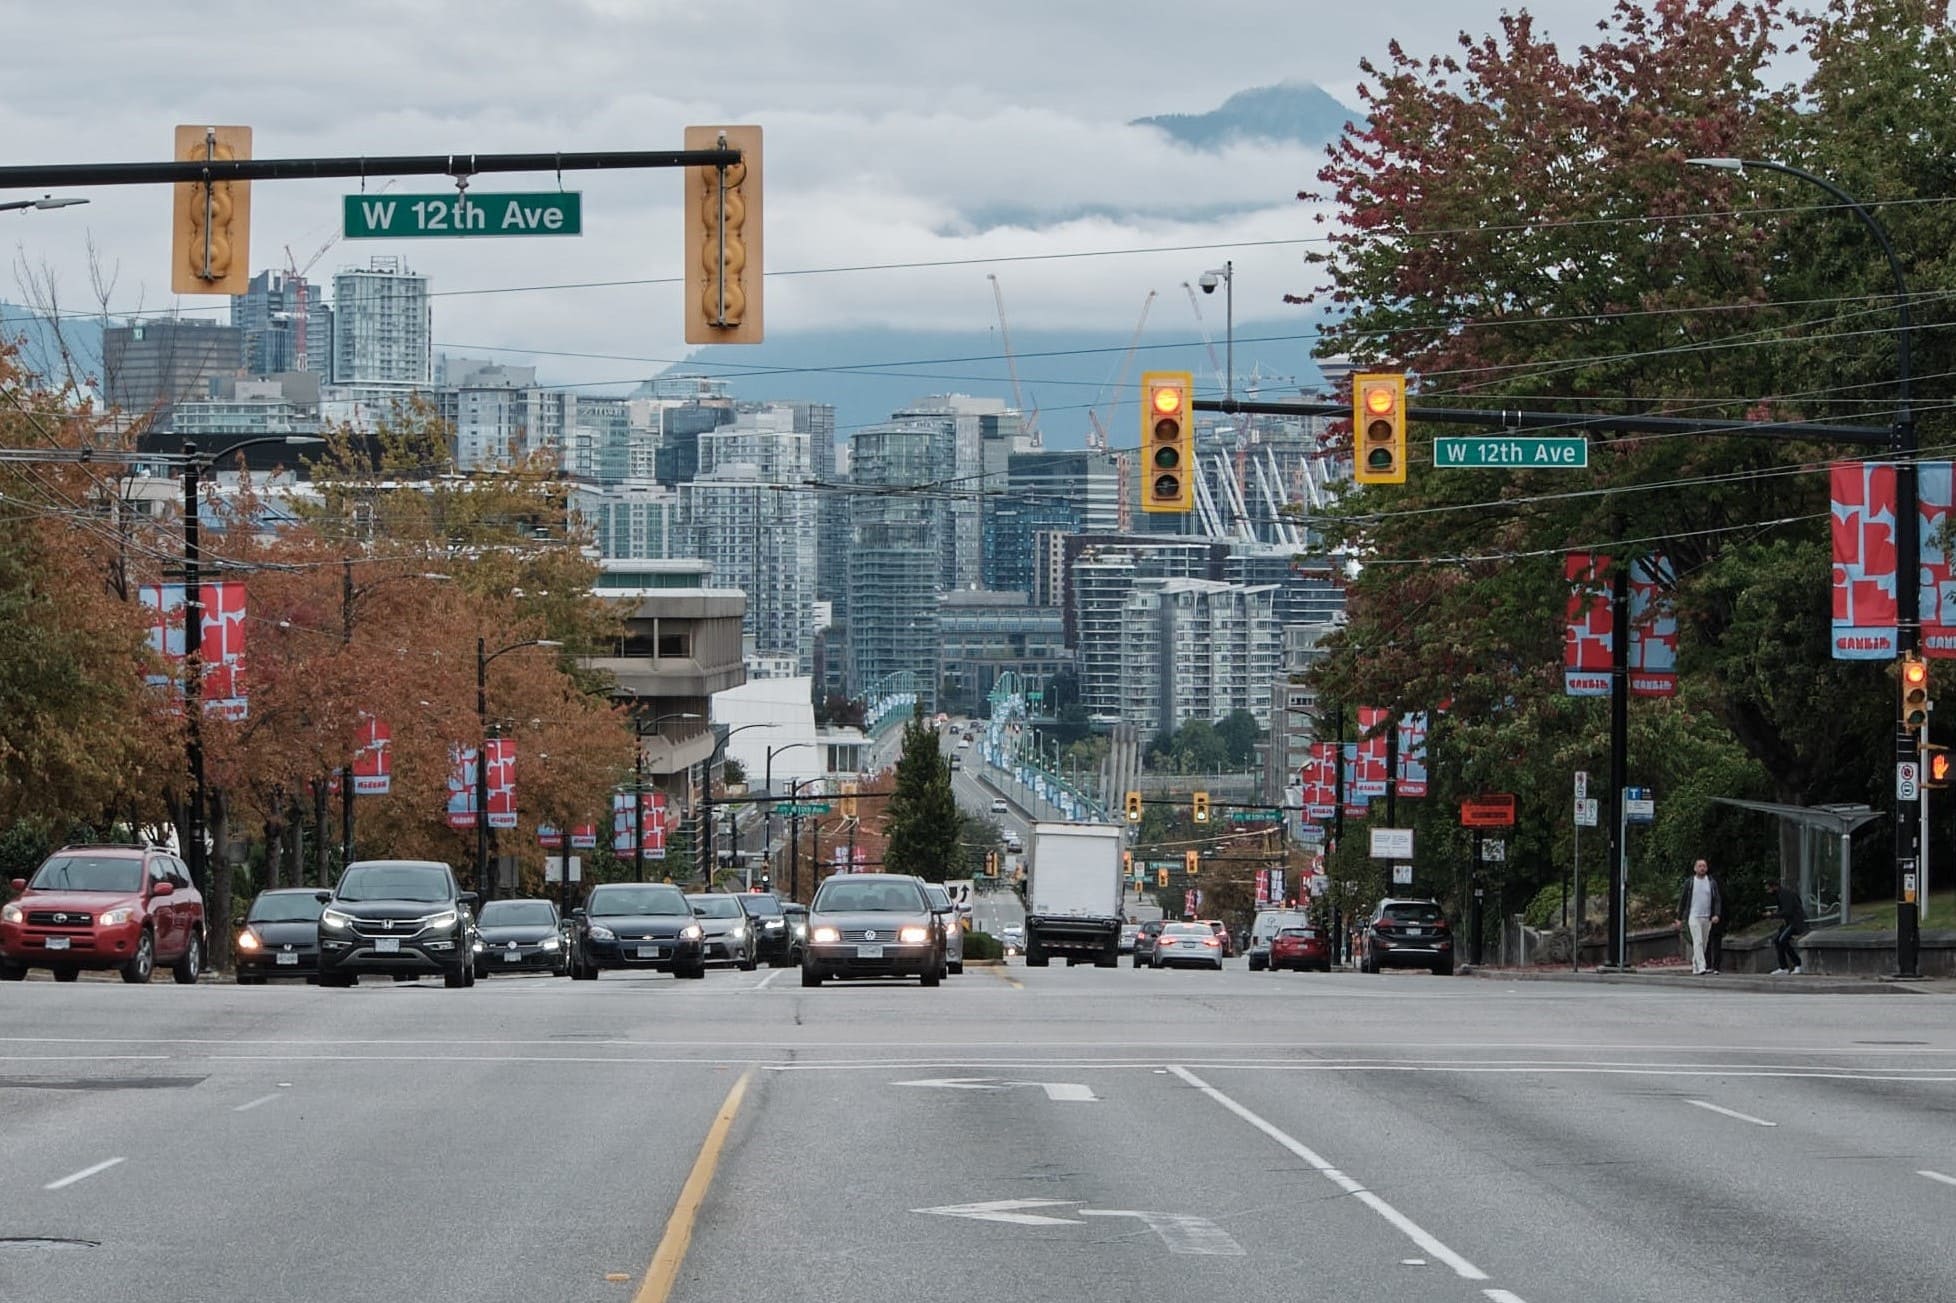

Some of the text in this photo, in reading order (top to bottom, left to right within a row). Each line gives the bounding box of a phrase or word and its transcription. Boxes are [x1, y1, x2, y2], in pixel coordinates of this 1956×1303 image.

[362, 200, 564, 230] W 12th Ave
[1446, 442, 1576, 463] W 12th Ave
